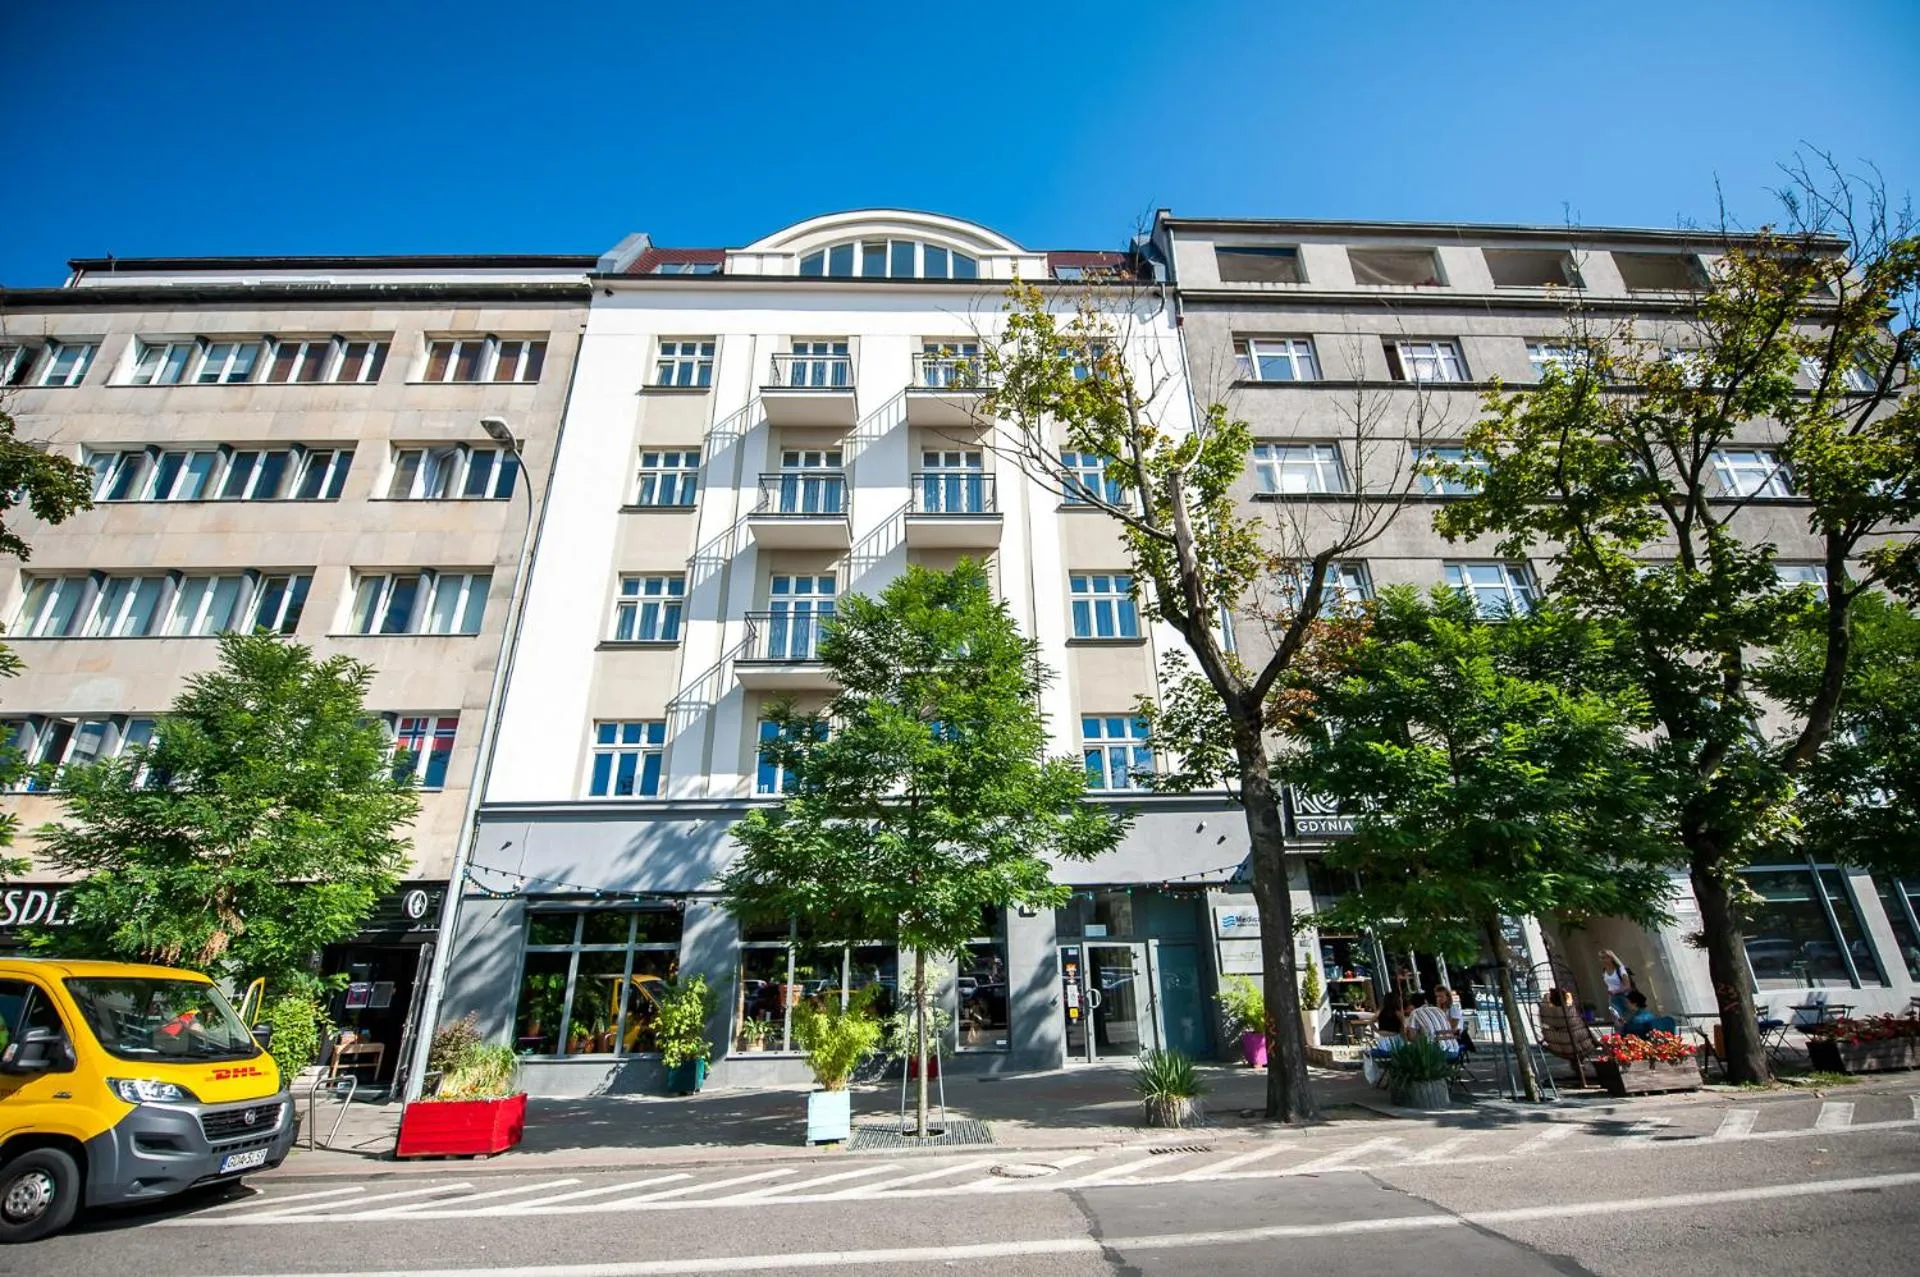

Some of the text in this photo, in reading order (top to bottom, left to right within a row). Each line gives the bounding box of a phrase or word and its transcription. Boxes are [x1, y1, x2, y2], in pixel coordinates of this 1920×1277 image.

[1297, 821, 1354, 832] GDYNIA
[1235, 915, 1260, 923] Medic
[212, 1066, 262, 1080] DHL
